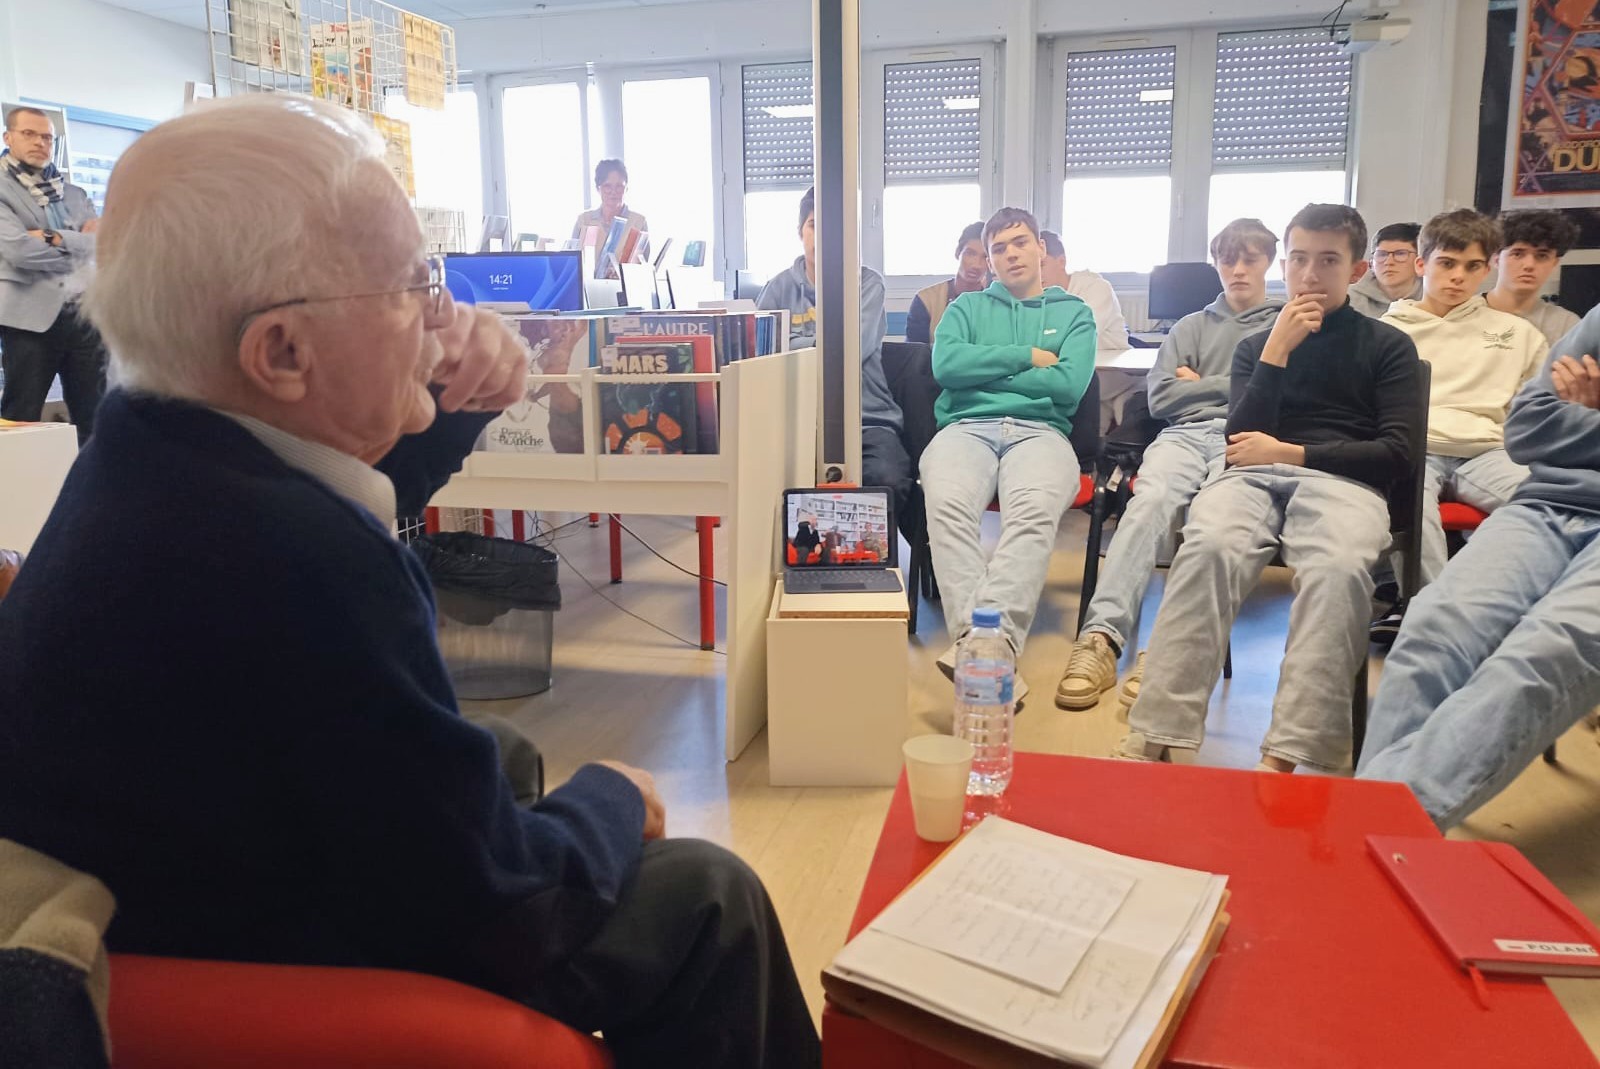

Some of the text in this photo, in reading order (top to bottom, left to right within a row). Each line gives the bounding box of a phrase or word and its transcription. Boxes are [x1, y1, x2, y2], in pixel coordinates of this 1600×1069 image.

[1553, 147, 1600, 172] DU
[489, 274, 513, 285] 14:21
[643, 322, 709, 335] L'AUTRE
[611, 354, 668, 373] MARS
